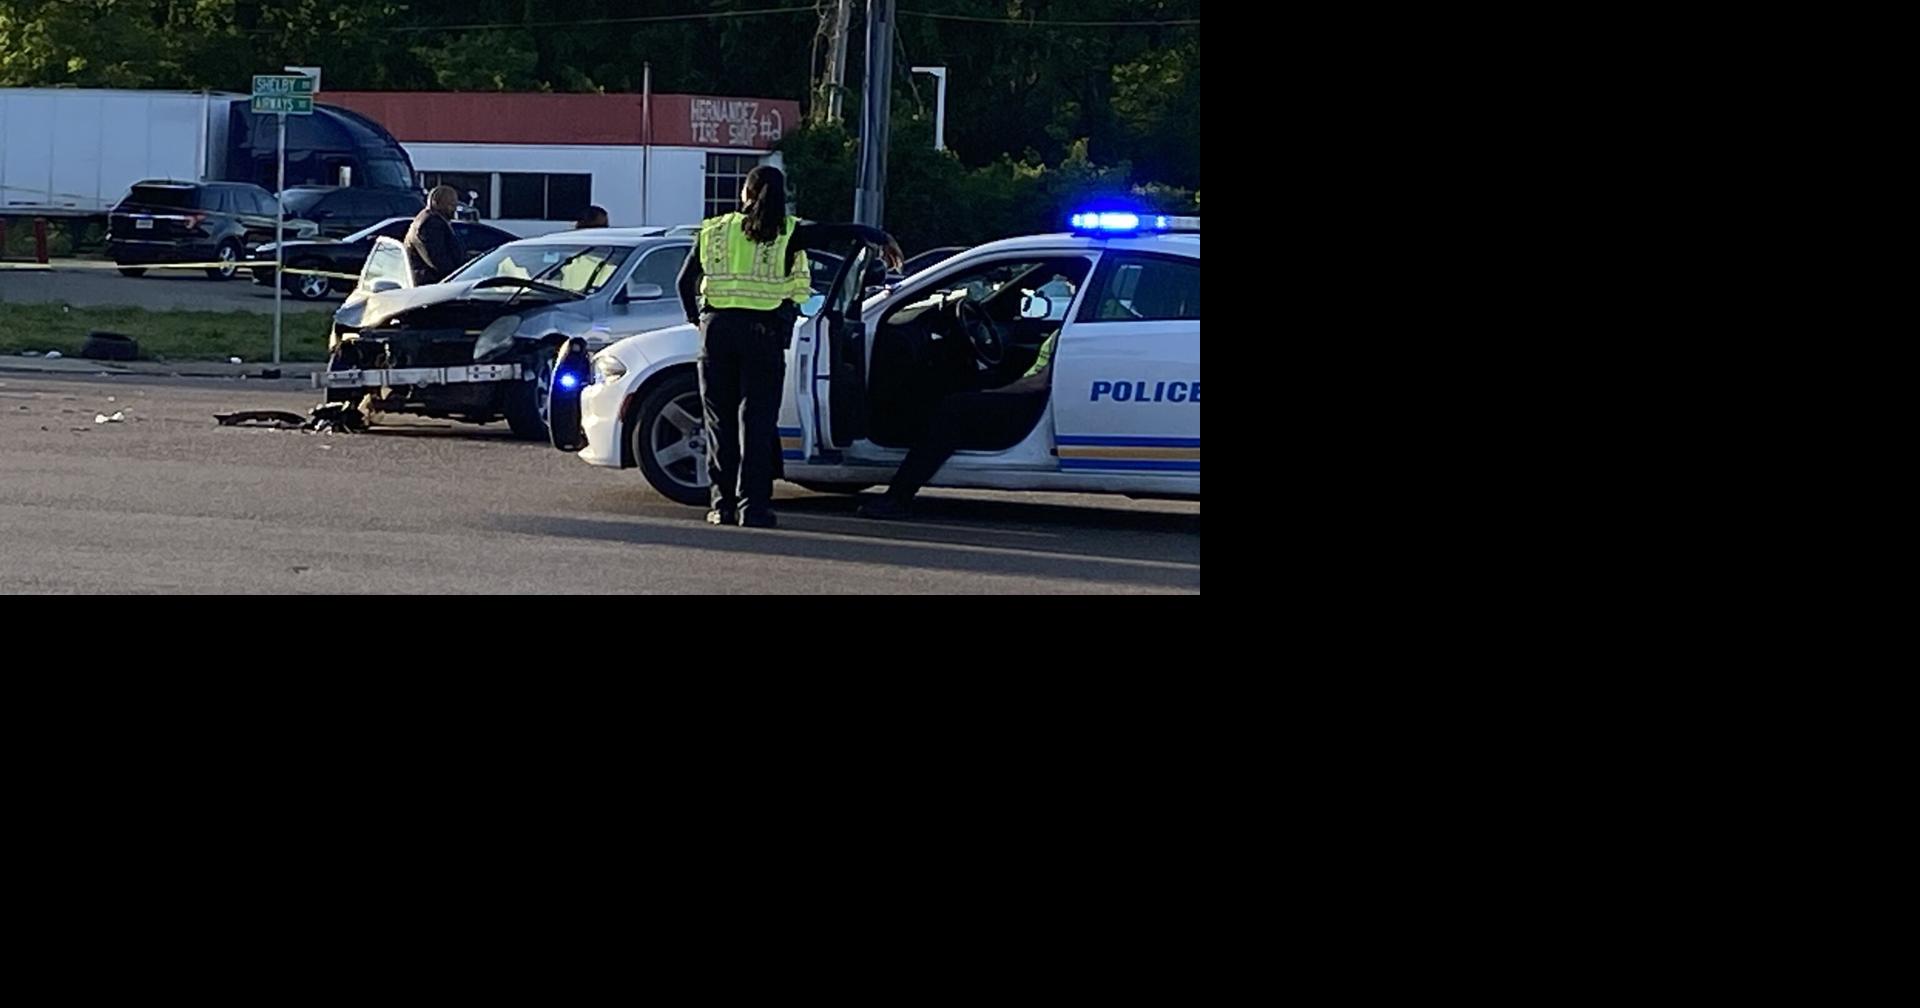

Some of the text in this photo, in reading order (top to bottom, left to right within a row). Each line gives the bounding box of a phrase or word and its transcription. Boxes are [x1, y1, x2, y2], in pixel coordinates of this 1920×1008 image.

[256, 78, 296, 92] SHELBY
[256, 97, 294, 111] AIRWAYS
[691, 98, 759, 124] HERNANDEZ
[691, 108, 782, 146] TIRE SHOP #2
[1089, 381, 1200, 403] POLICE
